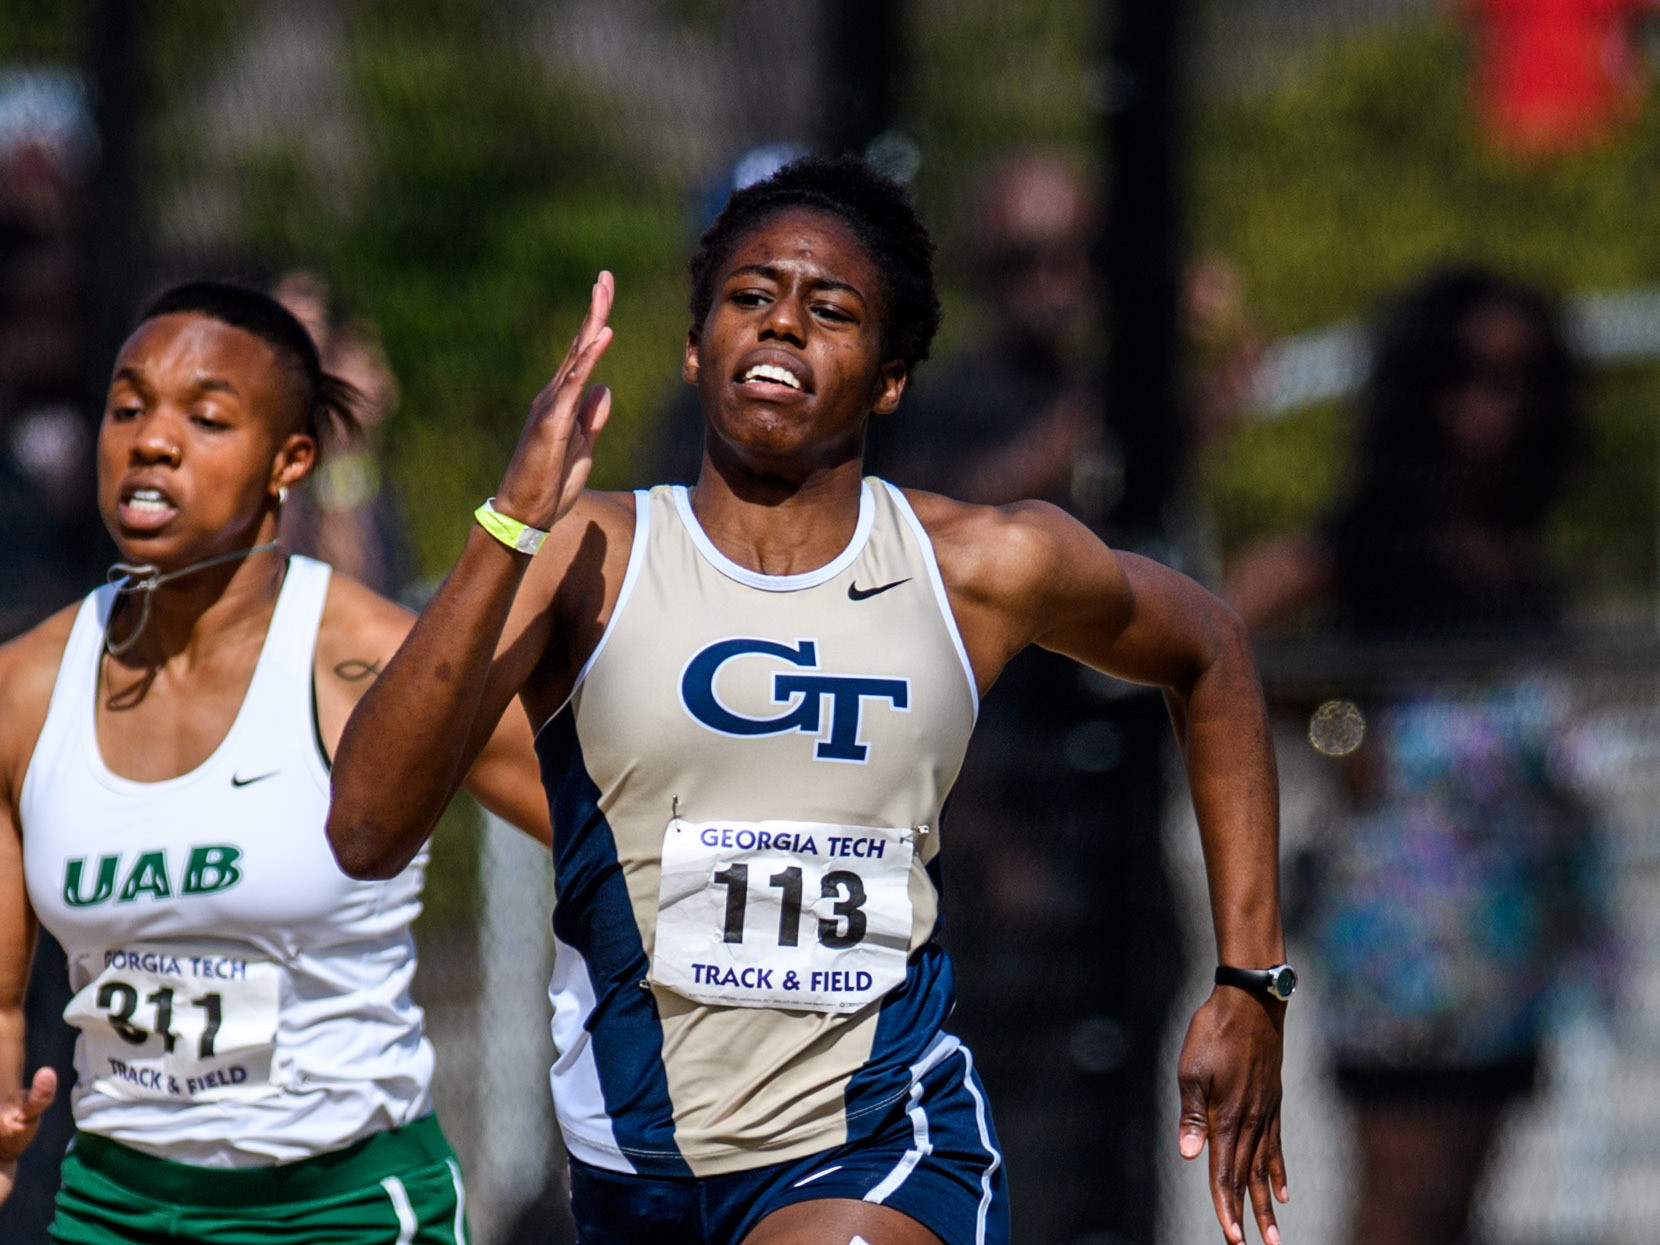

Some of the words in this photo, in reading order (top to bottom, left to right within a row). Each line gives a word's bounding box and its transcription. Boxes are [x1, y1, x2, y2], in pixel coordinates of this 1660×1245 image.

[678, 637, 911, 764] GT
[700, 827, 818, 855] GEORGIA
[828, 836, 885, 859] TECH
[63, 844, 243, 907] UAB
[713, 863, 868, 949] 113
[189, 957, 247, 980] TECH
[691, 963, 772, 990] TRACK
[782, 971, 801, 991] &
[810, 971, 873, 992] FIELD
[108, 1056, 161, 1090] TRACK
[167, 1075, 180, 1095] &
[186, 1065, 247, 1096] FIELD
